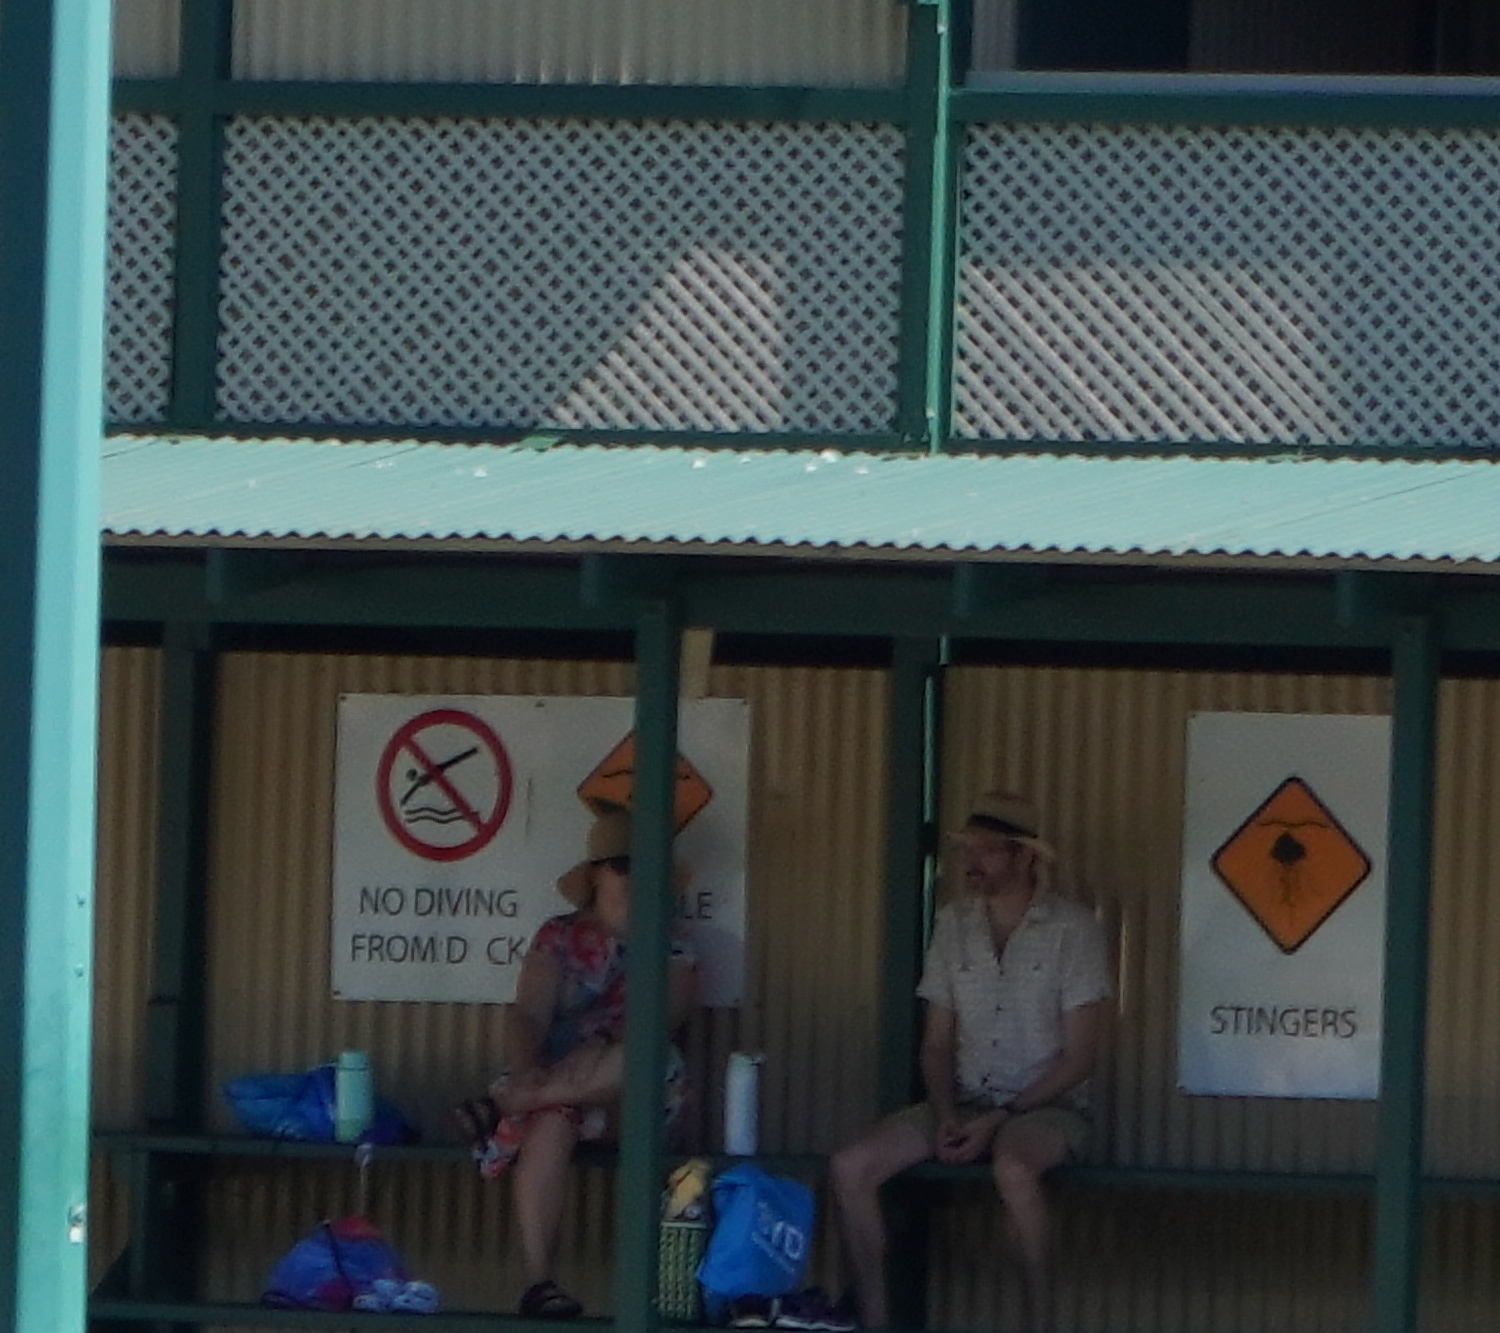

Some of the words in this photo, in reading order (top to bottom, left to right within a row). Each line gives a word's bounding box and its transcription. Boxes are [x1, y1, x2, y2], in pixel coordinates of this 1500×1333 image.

[357, 886, 405, 917] NO
[412, 888, 519, 919] DIVING
[350, 933, 436, 964] FROM
[446, 935, 528, 966] DCK
[1209, 1005, 1358, 1039] STINGERS
